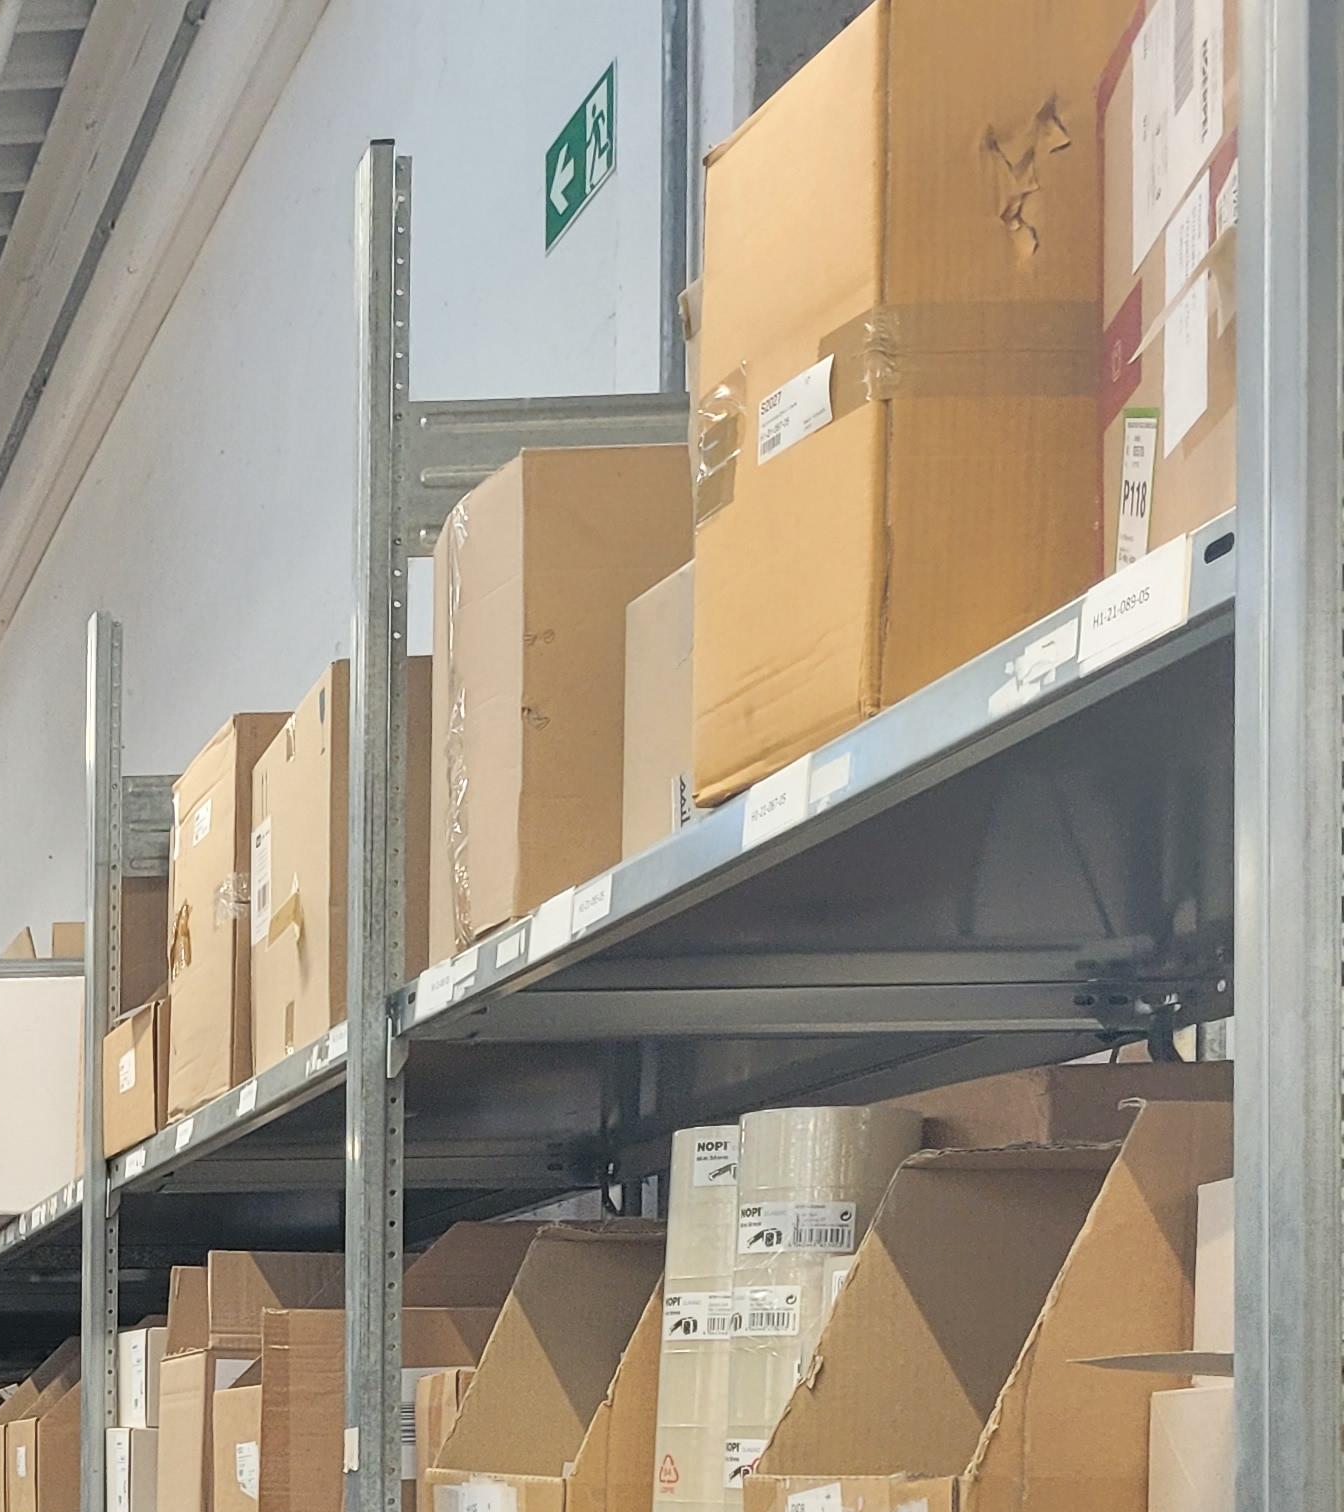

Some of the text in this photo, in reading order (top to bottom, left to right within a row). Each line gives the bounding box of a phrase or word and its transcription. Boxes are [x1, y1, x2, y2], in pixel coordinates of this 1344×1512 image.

[1122, 479, 1148, 519] P118
[1092, 586, 1151, 629] H1-21-089-05
[696, 1140, 730, 1153] NOPI
